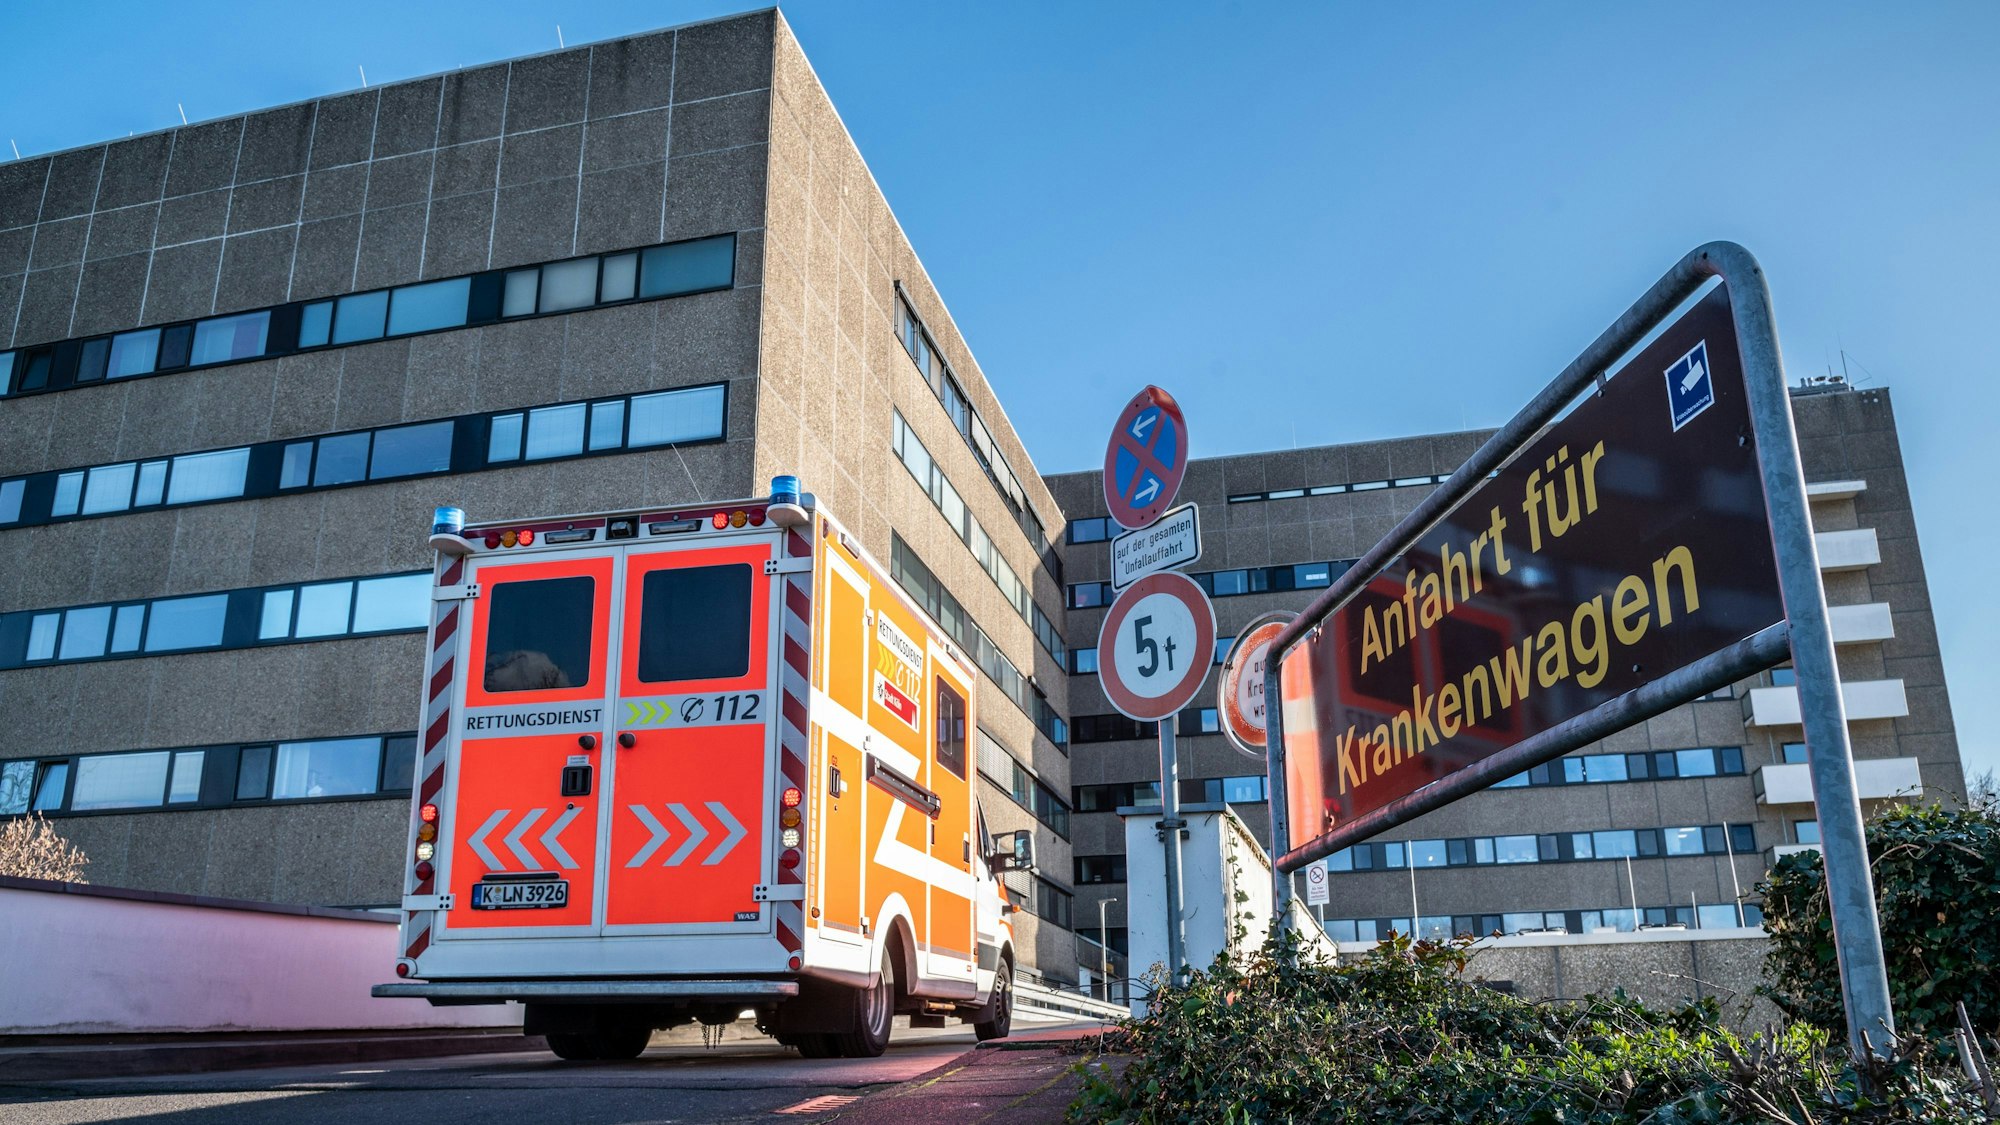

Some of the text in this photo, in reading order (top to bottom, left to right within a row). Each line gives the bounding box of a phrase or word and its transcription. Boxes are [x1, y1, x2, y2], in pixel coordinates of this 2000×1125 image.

[1116, 519, 1191, 560] auf der gesamten
[1125, 540, 1183, 575] Unfallauffahrt
[1360, 439, 1604, 675] Anfahrt für
[879, 619, 922, 670] RETTUNGSDIENST
[1134, 614, 1176, 678] 5 t
[905, 668, 921, 704] 112
[1336, 544, 1700, 795] Krankenwagen
[466, 708, 602, 731] RETTUNGSDIENST
[713, 693, 760, 722] 112
[526, 885, 565, 902] 3926
